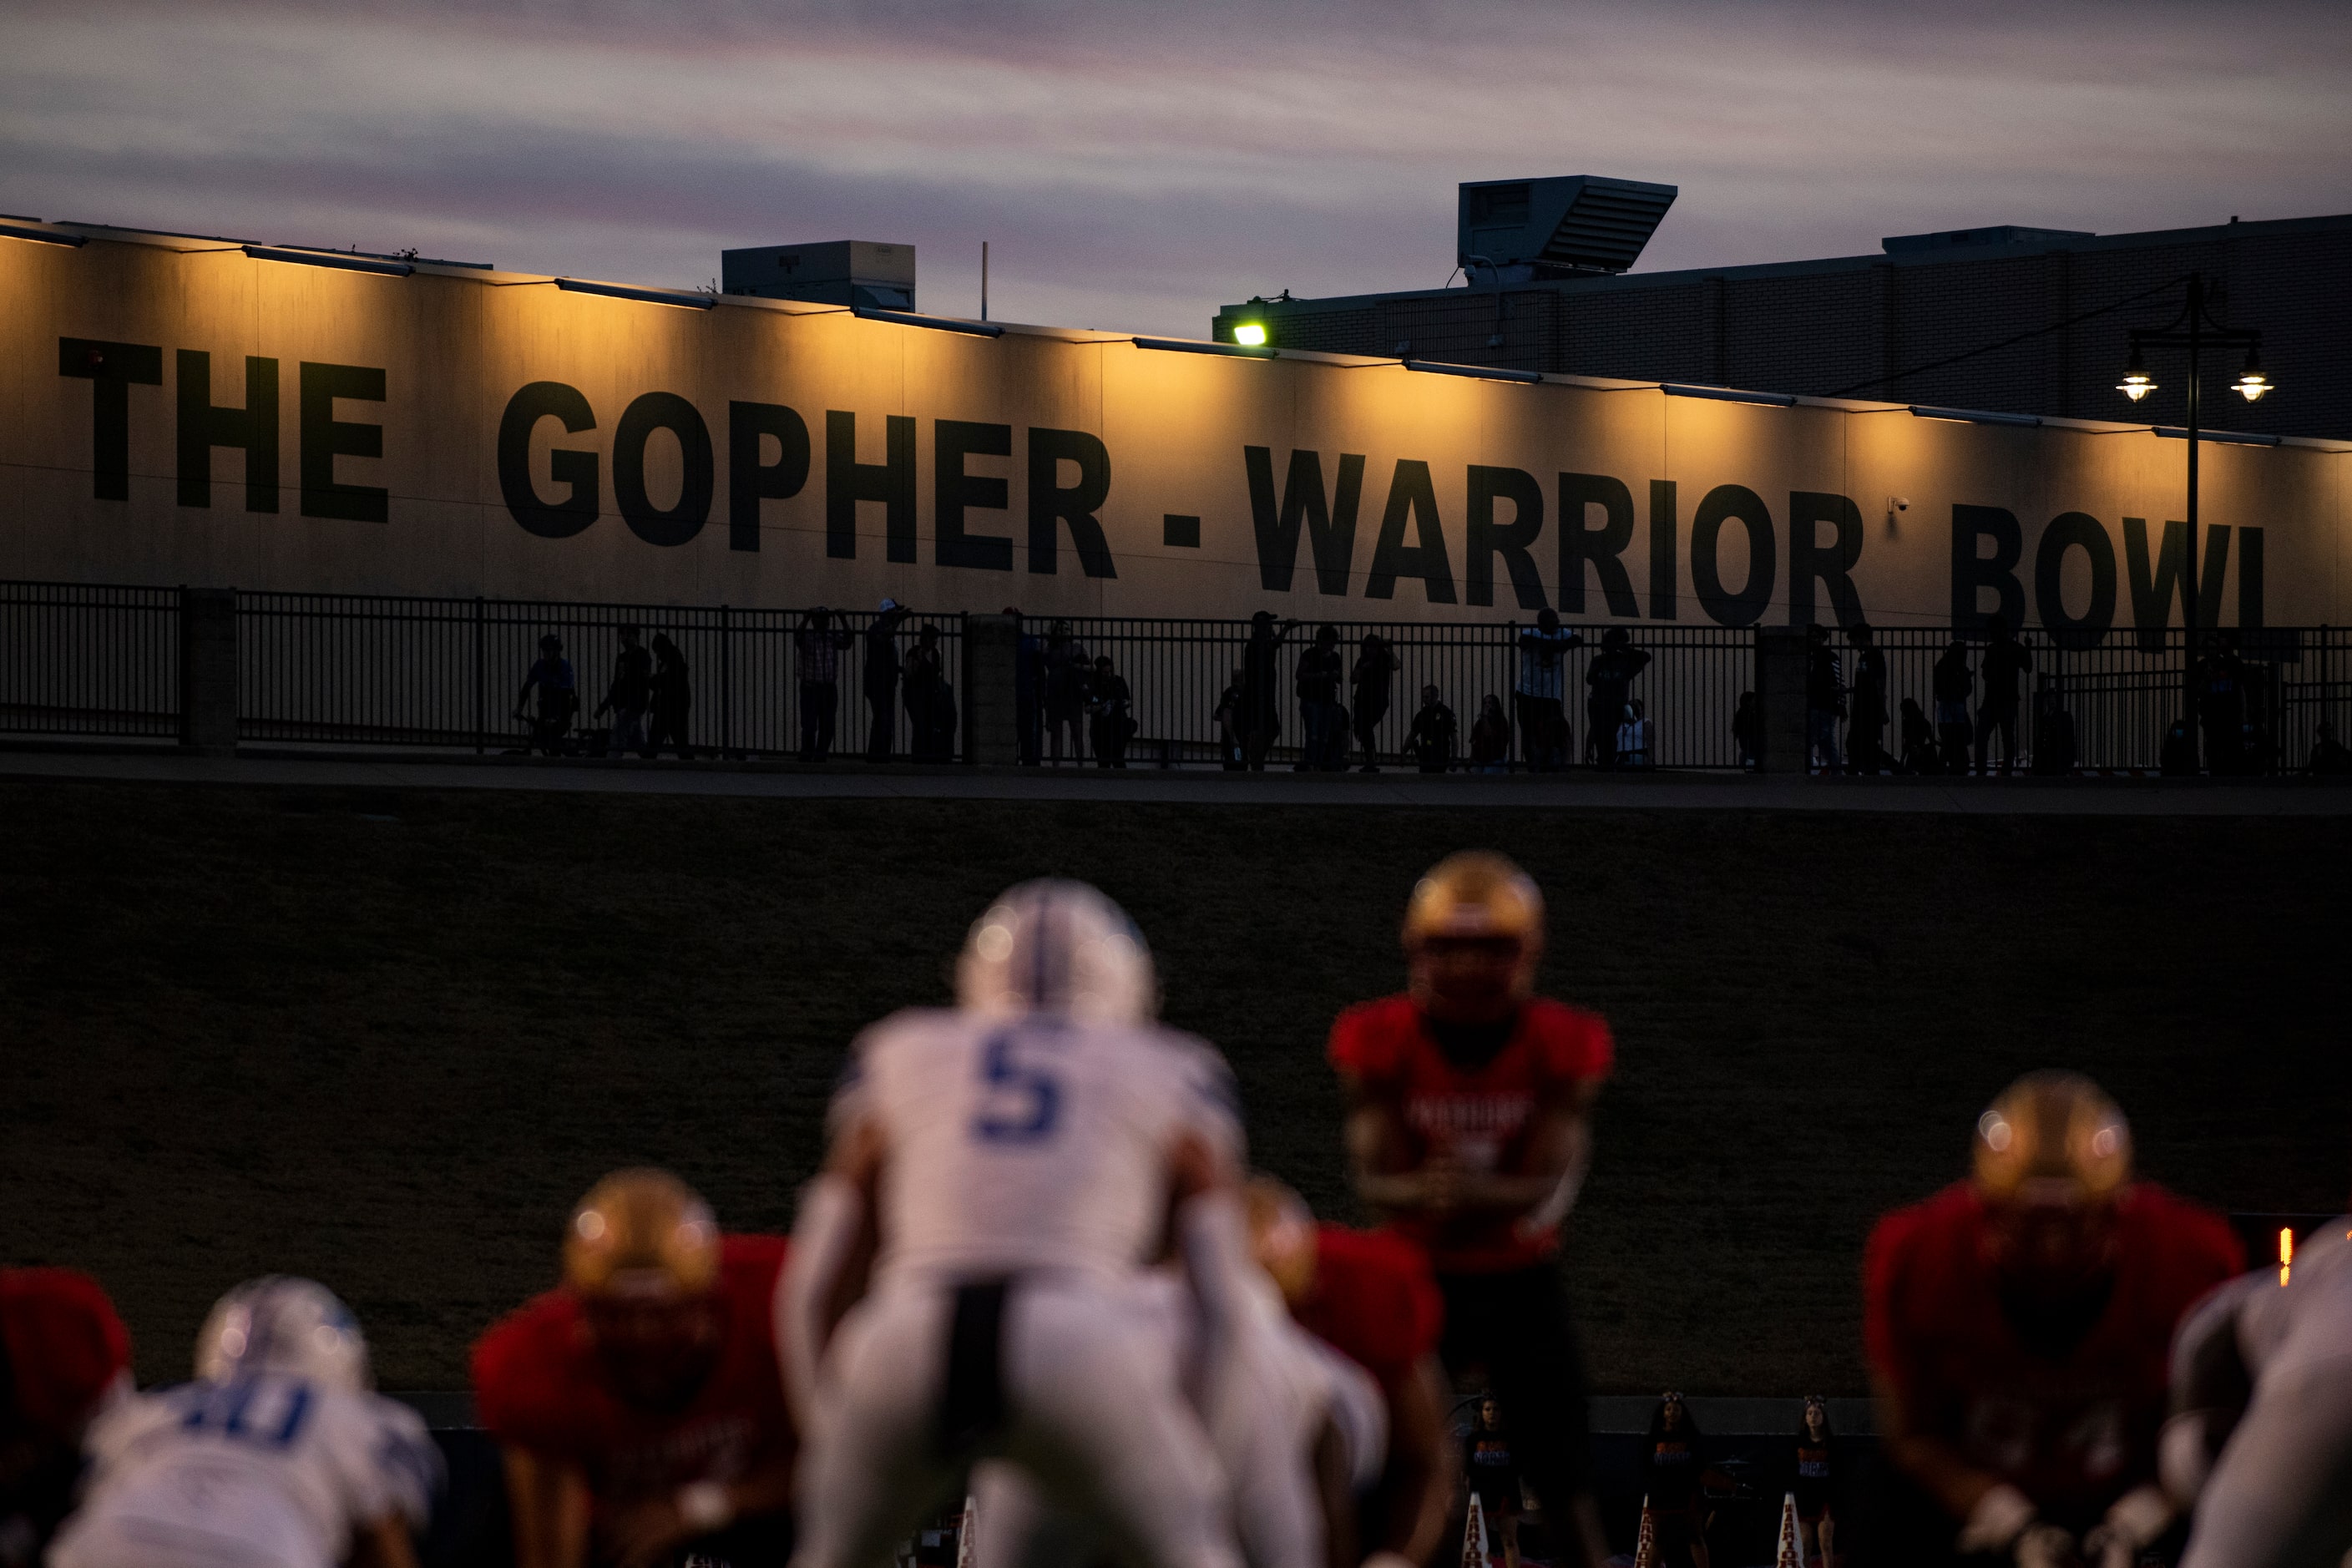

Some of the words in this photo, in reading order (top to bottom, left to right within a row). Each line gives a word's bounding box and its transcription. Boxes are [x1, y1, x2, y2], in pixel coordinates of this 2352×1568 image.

[59, 336, 388, 524] THE
[498, 382, 1117, 579] GOPHER
[1164, 513, 1200, 548] -
[1244, 445, 1866, 630] WARRIOR
[1951, 503, 2299, 663] BOWL
[970, 1024, 1065, 1146] 5
